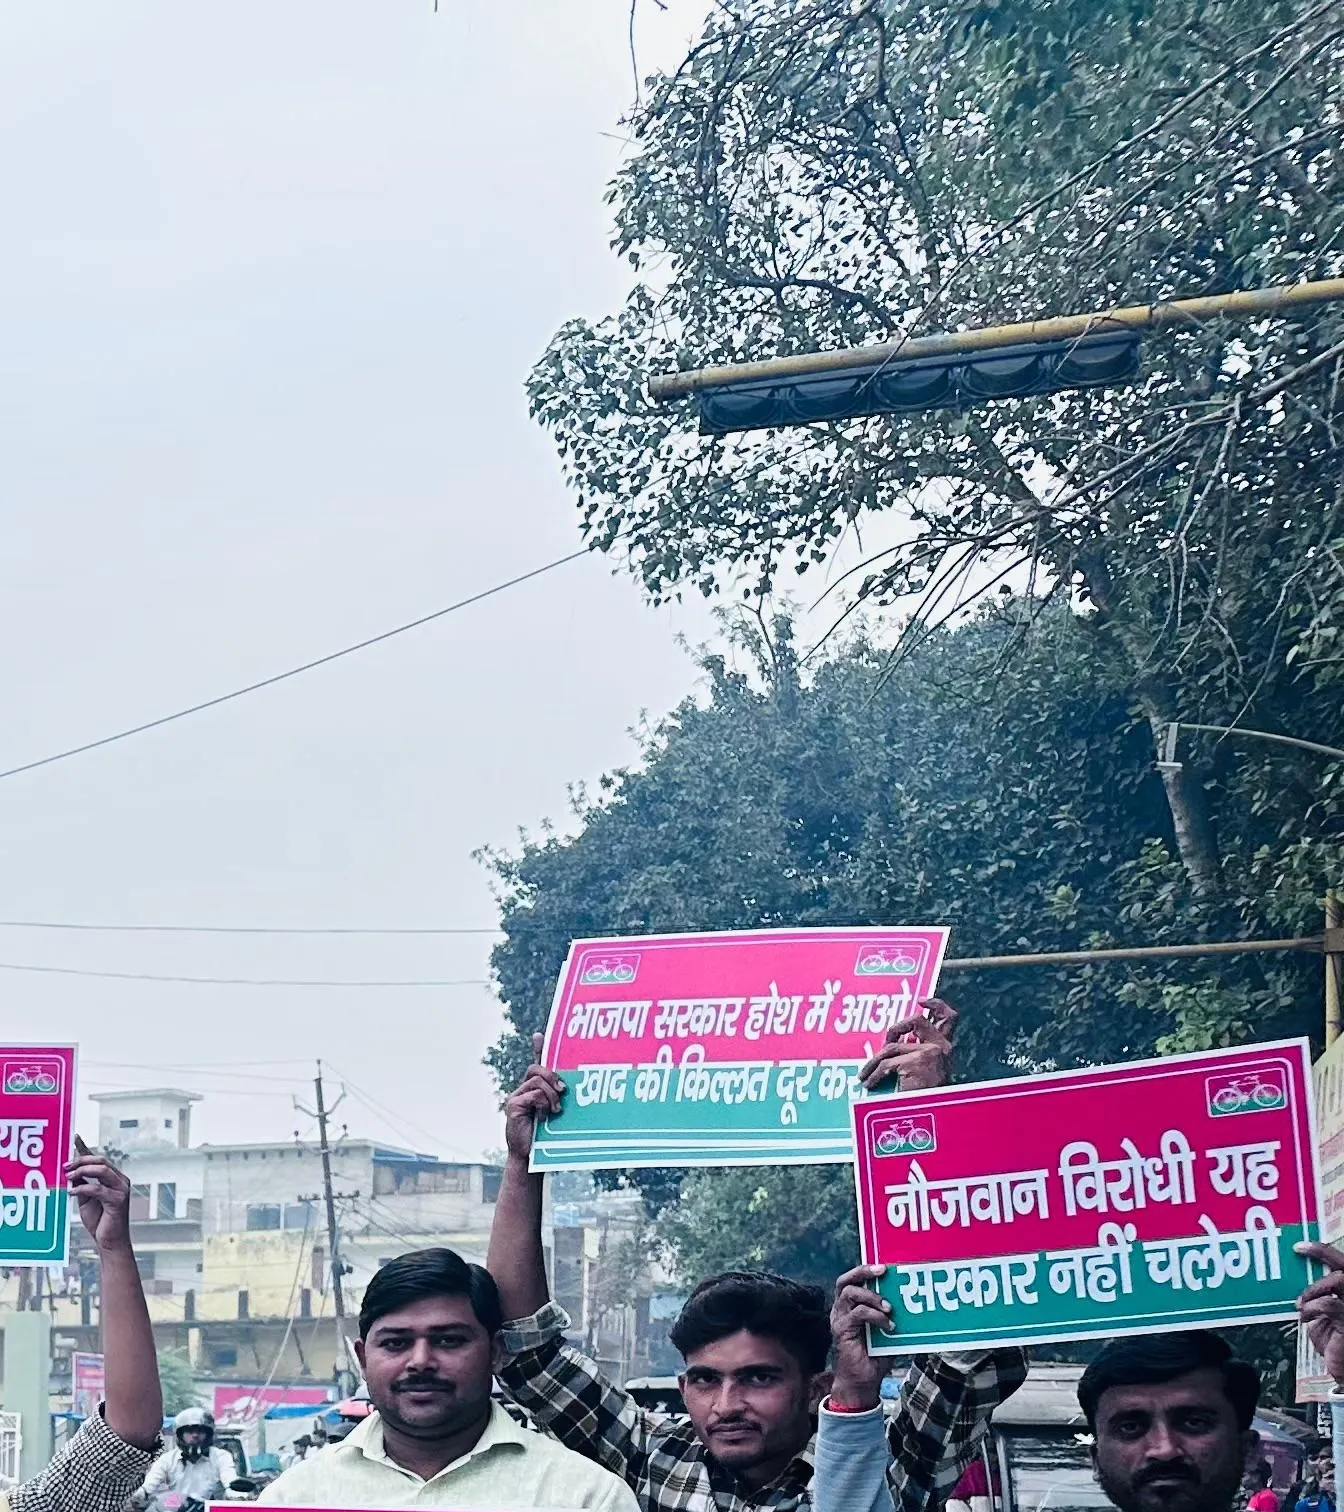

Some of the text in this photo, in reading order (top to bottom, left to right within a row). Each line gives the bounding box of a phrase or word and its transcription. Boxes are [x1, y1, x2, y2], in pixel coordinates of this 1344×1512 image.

[566, 978, 912, 1040] भाजपा सरकार होश में आओ
[575, 1062, 633, 1107] खाद
[634, 1044, 675, 1103] की
[675, 1044, 775, 1105] किल्लत
[776, 1059, 817, 1126] दूर
[884, 1158, 1049, 1232] नौजवान
[1058, 1129, 1197, 1216] विरोधी
[1205, 1141, 1281, 1202] यह
[897, 1205, 1283, 1314] सरकार नहीं चलेगी
